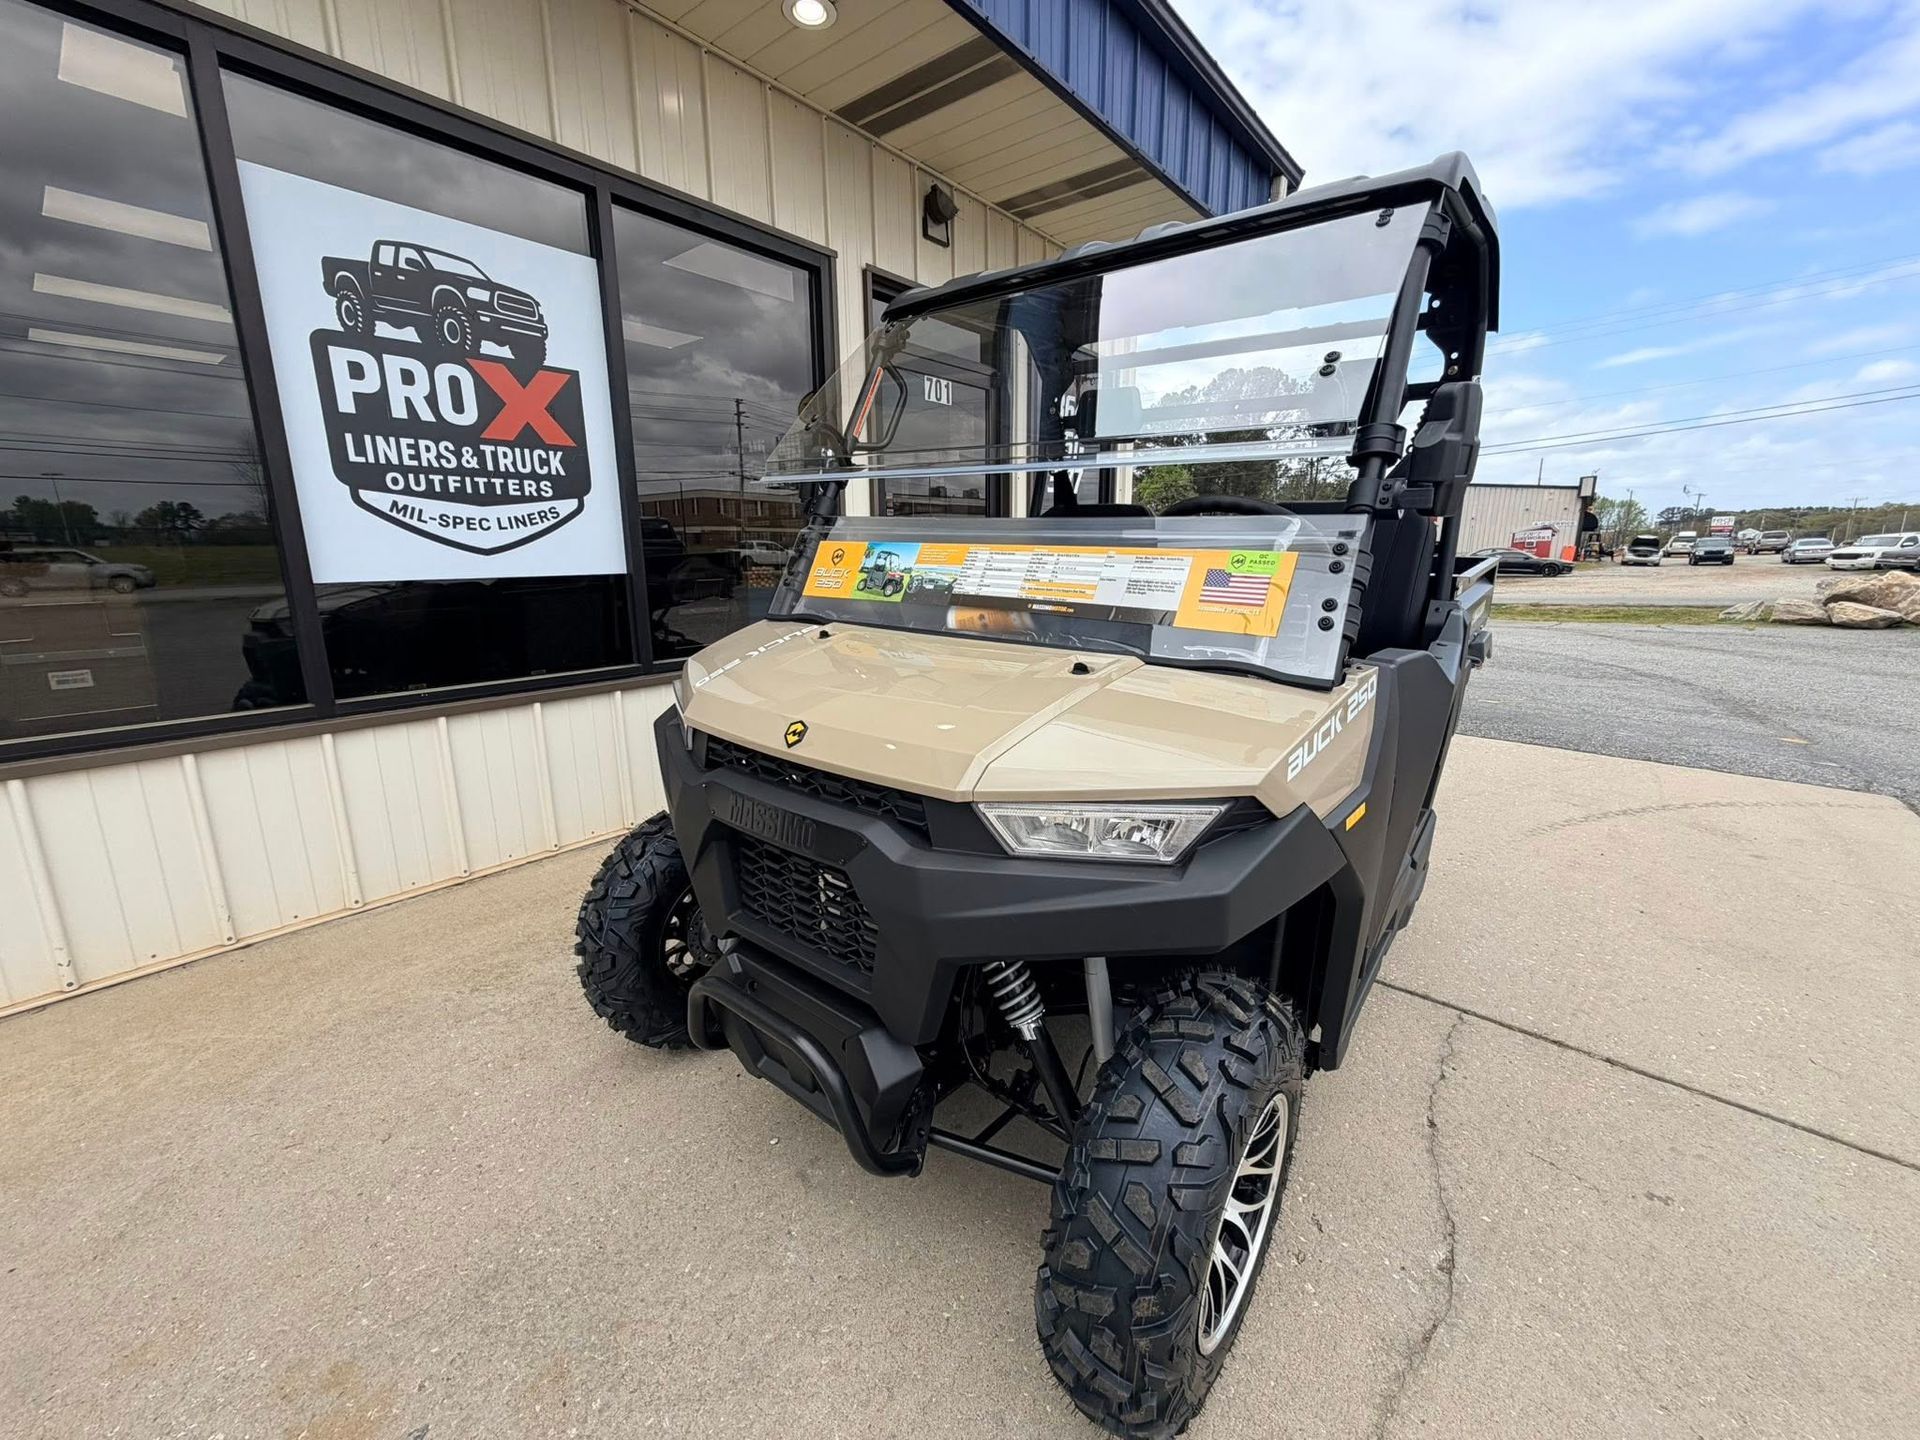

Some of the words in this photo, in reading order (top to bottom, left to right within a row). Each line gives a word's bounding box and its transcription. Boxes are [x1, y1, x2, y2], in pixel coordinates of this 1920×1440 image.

[926, 376, 950, 404] 701
[344, 432, 458, 469] LINERS
[461, 446, 478, 469] &
[479, 444, 567, 476] TRUCK
[385, 472, 554, 498] OUTFITTERS
[389, 500, 492, 532] MIL-SPEC
[497, 506, 560, 531] LINERS
[814, 567, 851, 578] BUCK
[814, 578, 843, 588] 250
[1286, 707, 1343, 784] BUCK
[1346, 674, 1376, 725] 250
[730, 790, 817, 853] MASSIMO
